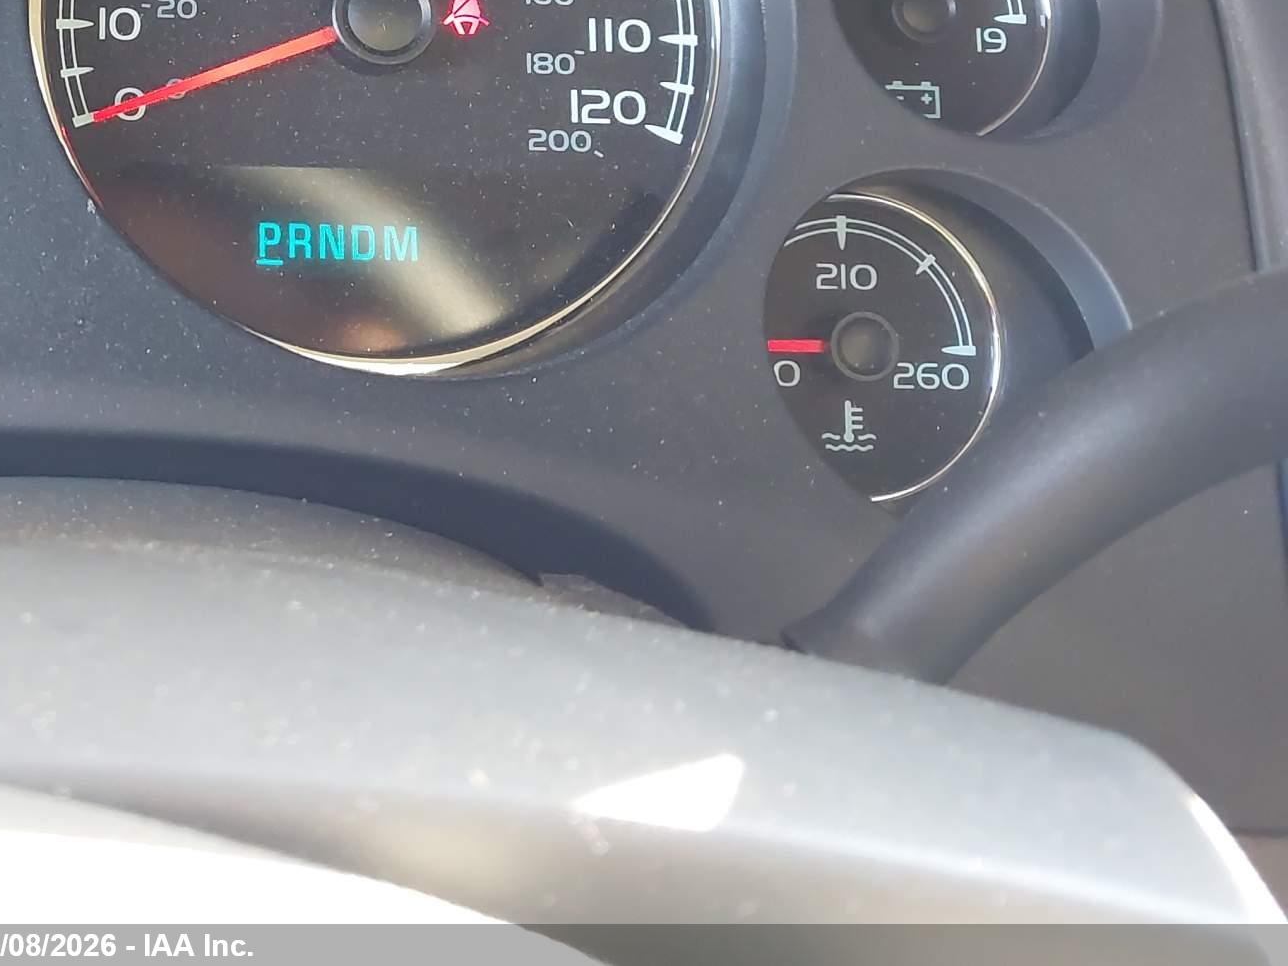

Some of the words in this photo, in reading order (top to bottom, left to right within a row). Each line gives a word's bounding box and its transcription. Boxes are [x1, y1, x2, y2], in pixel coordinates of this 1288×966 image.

[98, 7, 142, 41] 10
[588, 17, 651, 53] 110
[975, 27, 1007, 53] 19
[526, 52, 576, 75] 180
[114, 87, 146, 121] 0
[570, 89, 646, 125] 120
[528, 129, 592, 153] 200
[815, 263, 878, 291] 210
[893, 362, 970, 390] 260
